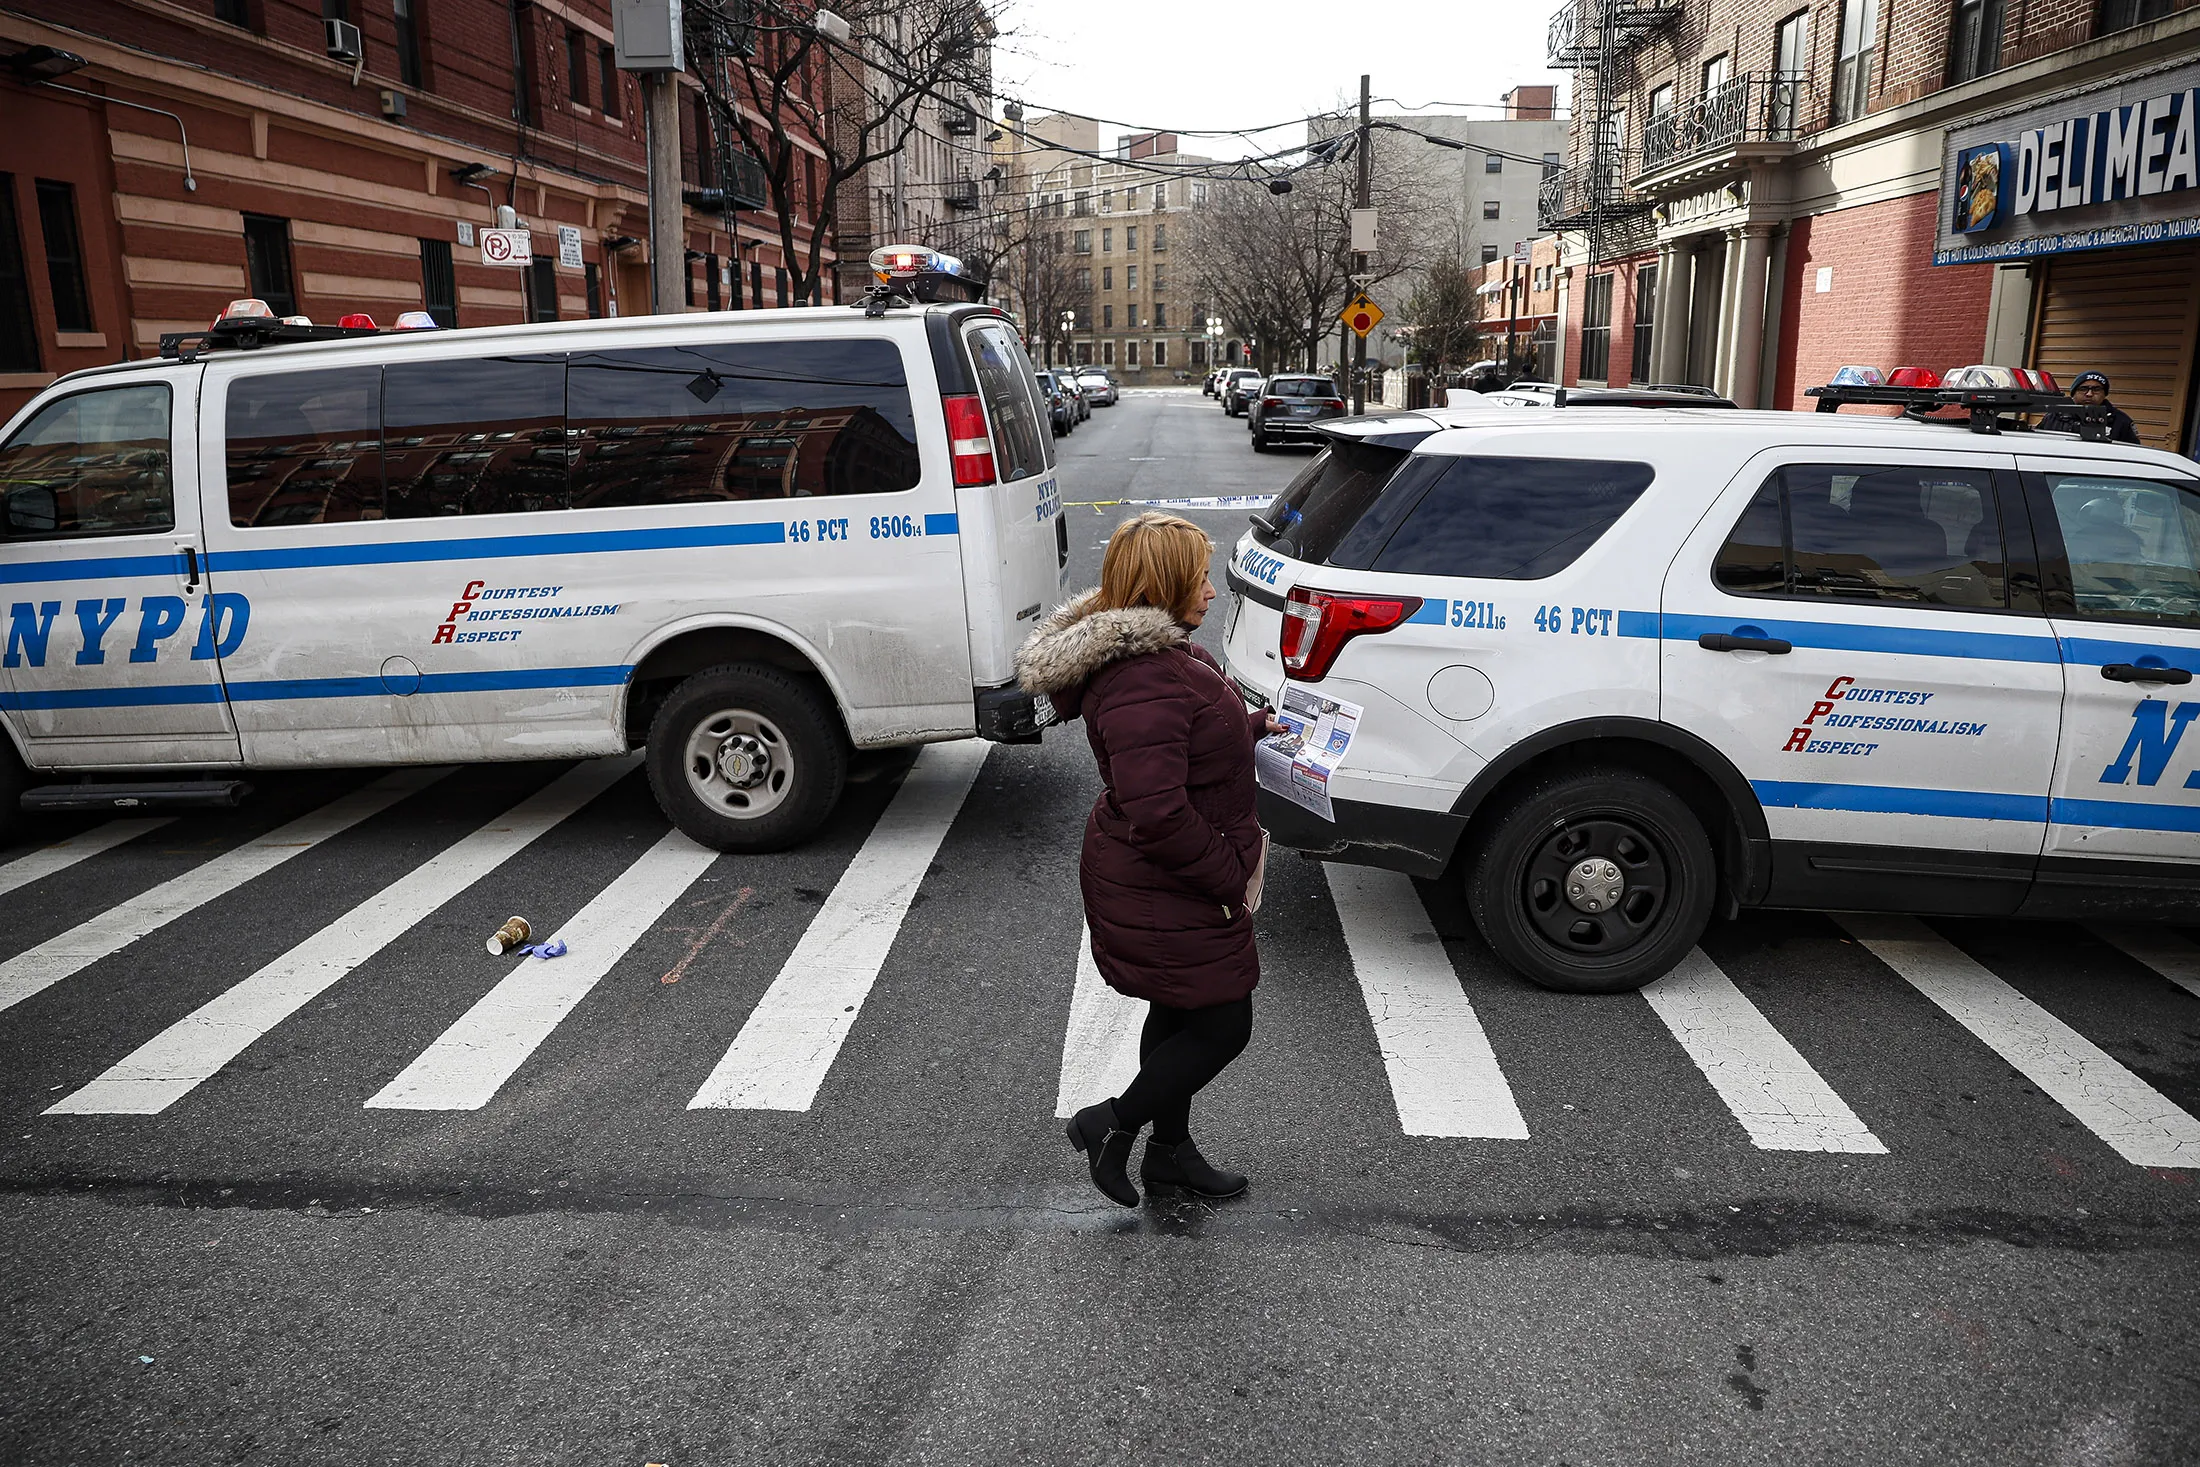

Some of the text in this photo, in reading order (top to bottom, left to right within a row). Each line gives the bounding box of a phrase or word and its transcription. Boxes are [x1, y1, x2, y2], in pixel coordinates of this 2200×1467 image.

[2014, 113, 2098, 216] DELI
[1937, 252, 1949, 264] 931
[1951, 251, 1963, 263] HOT
[1969, 247, 1984, 260] COLD
[2024, 239, 2038, 254] HOT
[2039, 237, 2058, 251] FOOD
[2061, 231, 2092, 249] HISPANIC
[2100, 224, 2139, 245] AMERICAN
[2140, 223, 2162, 241] FOOD
[788, 519, 810, 543] 46
[817, 518, 849, 541] PCT
[1240, 548, 1285, 585] POLICE
[461, 580, 564, 601] COURTESY
[445, 601, 619, 623] PROFESSIONALISM
[1534, 605, 1562, 633] 46
[1570, 607, 1613, 636] PCT
[2, 592, 251, 669] NYPD
[432, 624, 522, 644] RESPECT
[1824, 675, 1934, 705] COURTESY
[1802, 700, 1988, 736] PROFESSIONALISM
[1781, 727, 1879, 756] RESPECT
